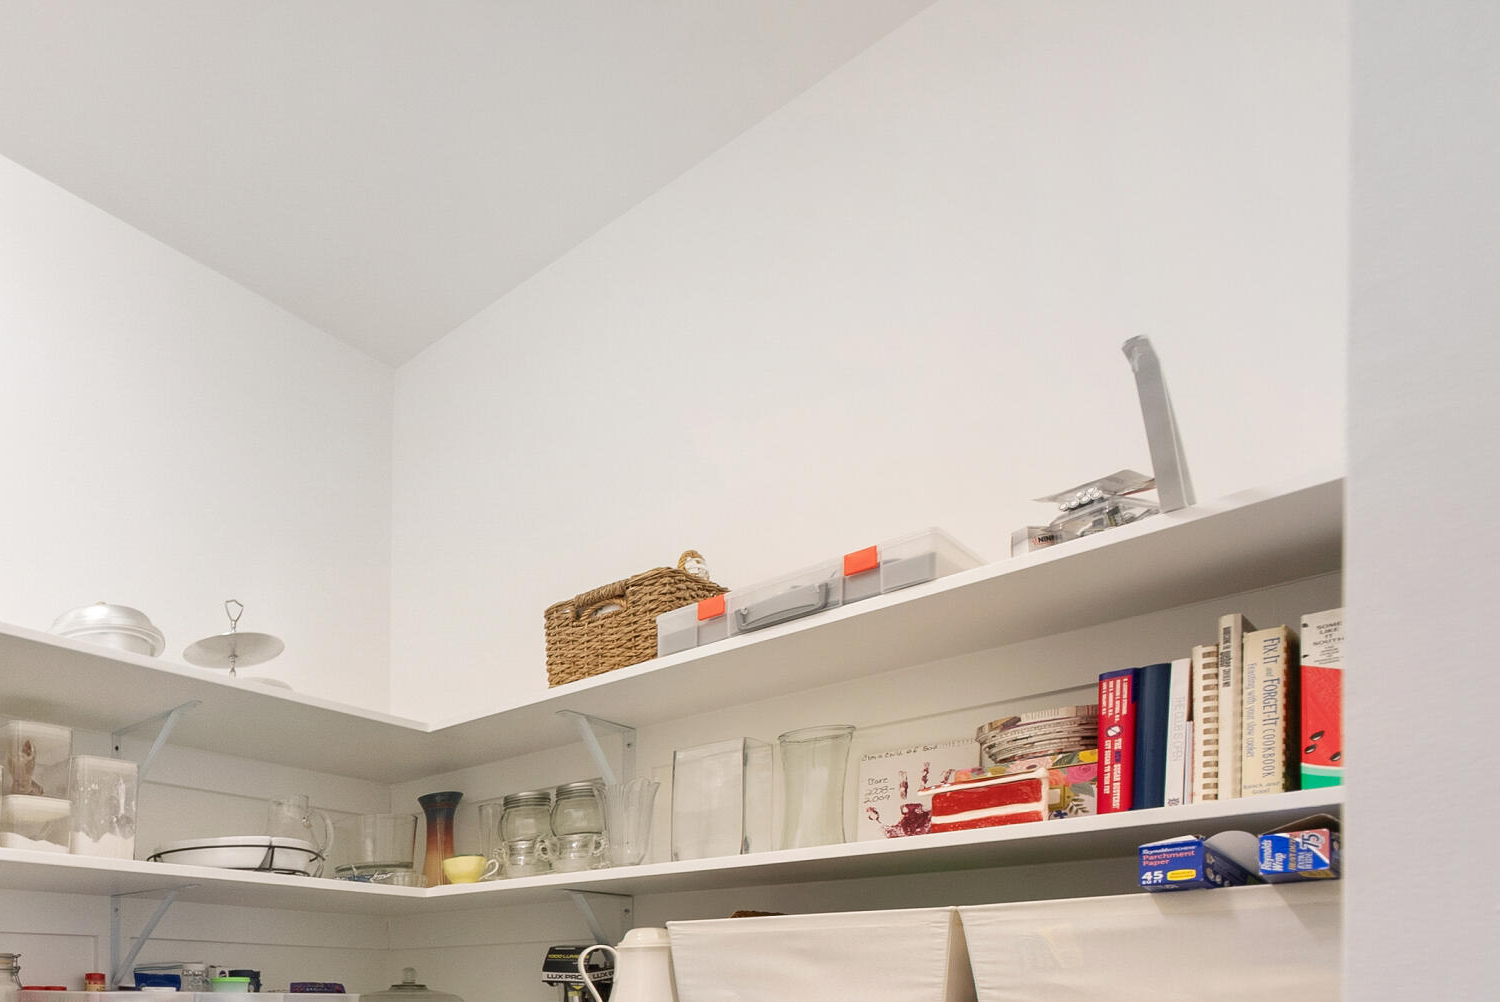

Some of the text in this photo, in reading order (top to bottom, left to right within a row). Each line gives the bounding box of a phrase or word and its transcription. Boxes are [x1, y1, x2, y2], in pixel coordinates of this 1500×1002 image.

[1316, 620, 1342, 631] SOME
[1319, 627, 1340, 635] LIKE
[1247, 662, 1257, 690] Feasting
[1247, 691, 1256, 705] with
[1246, 705, 1256, 720] your
[1247, 721, 1256, 736] slow
[1262, 728, 1276, 778] COOKBOOK
[1301, 832, 1322, 849] 75
[1142, 850, 1196, 861] Parchment
[1261, 839, 1273, 870] Reynolds
[1271, 852, 1287, 871] Wrap
[1142, 859, 1170, 867] Paper
[1141, 870, 1164, 881] 45
[592, 971, 607, 979] LUX
